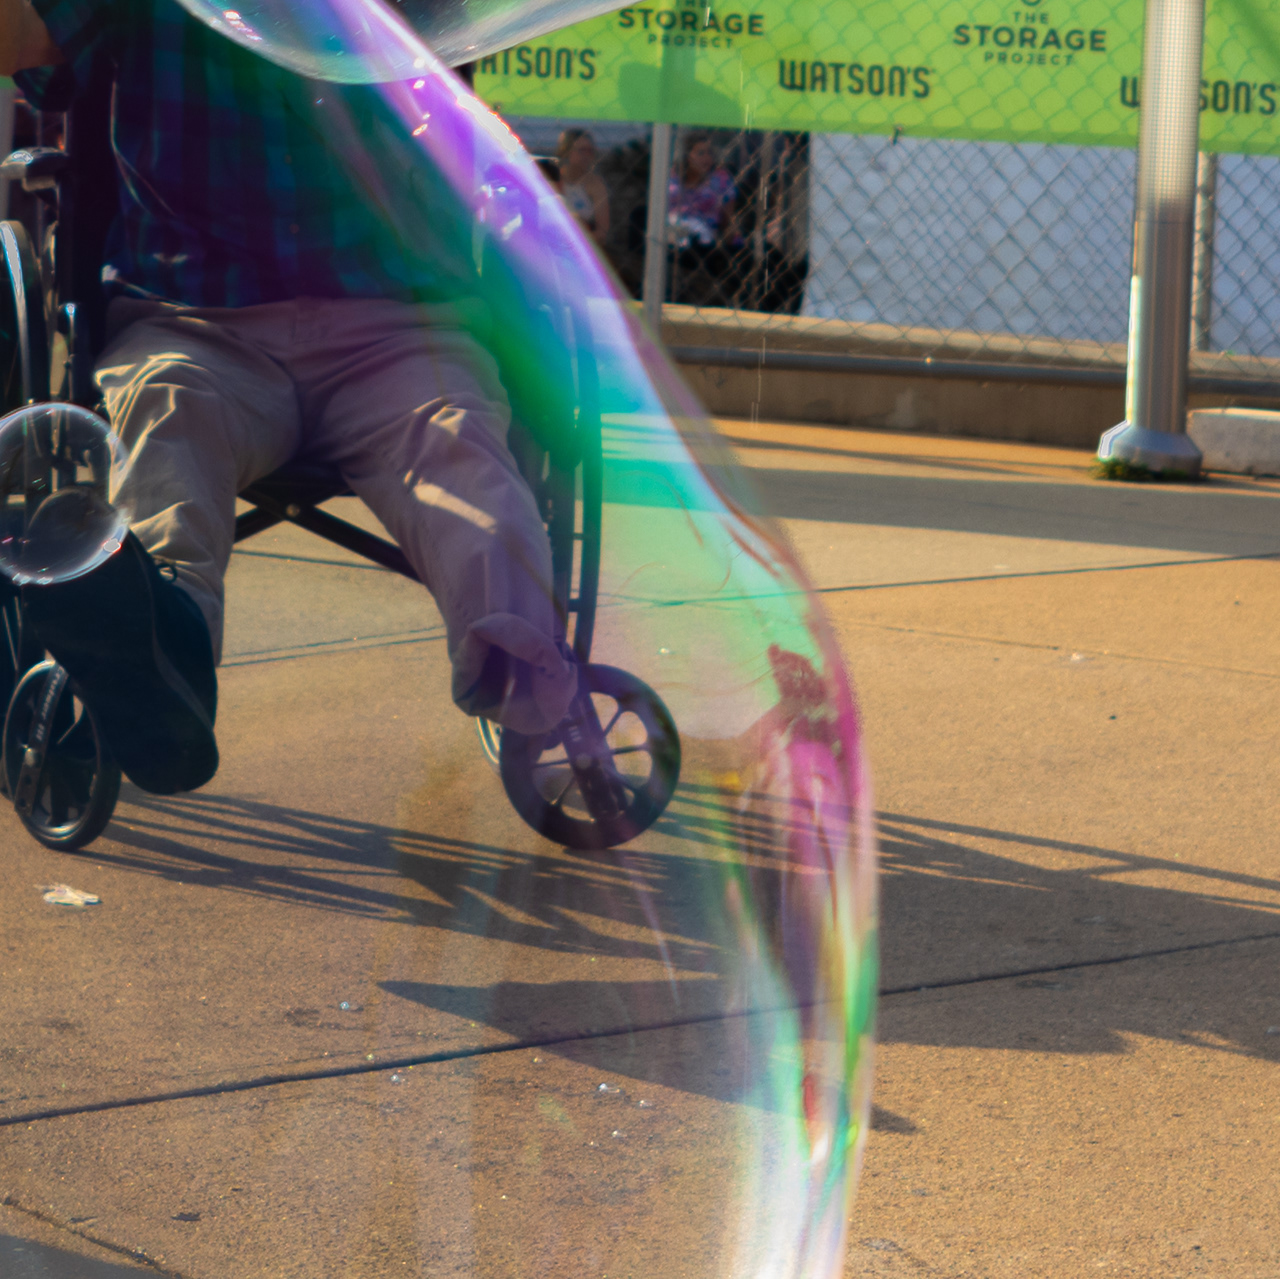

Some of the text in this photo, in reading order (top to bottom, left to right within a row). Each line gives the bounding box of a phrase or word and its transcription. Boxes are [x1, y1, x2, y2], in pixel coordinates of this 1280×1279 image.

[619, 9, 764, 36] STORAGE
[954, 25, 1106, 51] STORAGE
[476, 47, 596, 80] ATSON'S
[778, 59, 930, 98] WATSON'S
